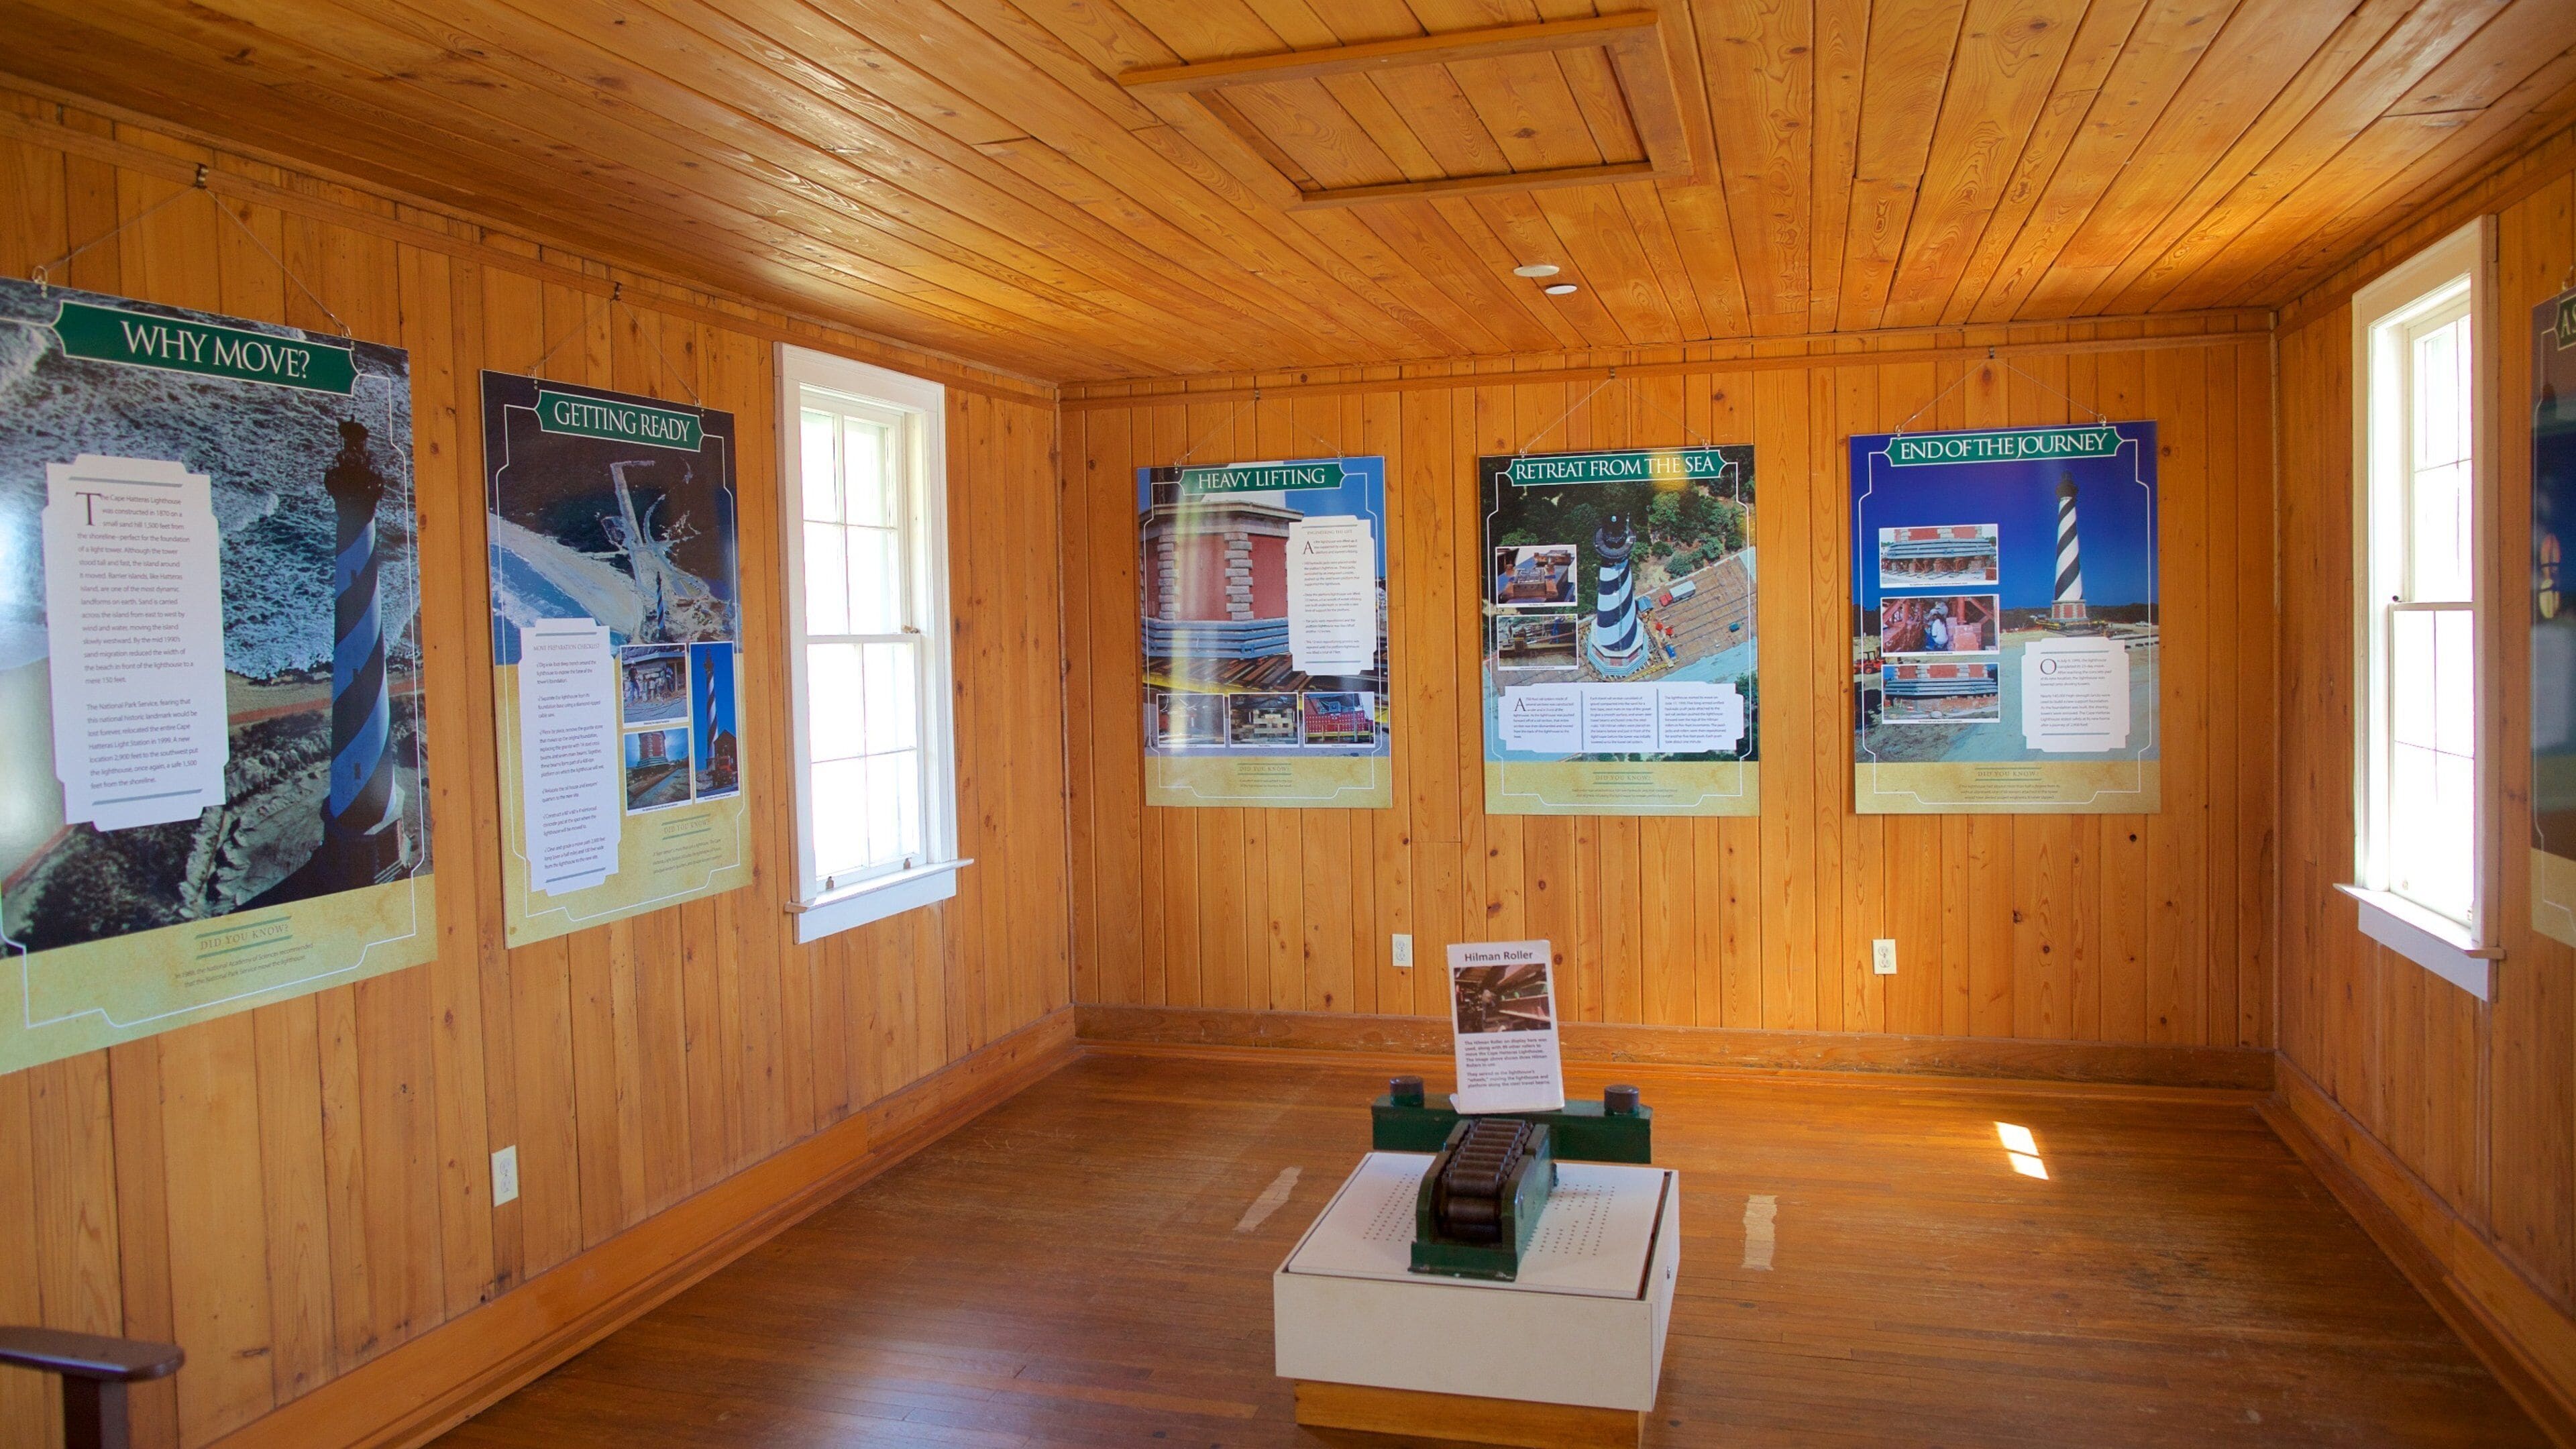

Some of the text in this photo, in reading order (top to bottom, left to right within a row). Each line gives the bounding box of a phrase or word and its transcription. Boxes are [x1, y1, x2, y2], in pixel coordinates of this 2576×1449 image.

[120, 320, 311, 379] WHY MOVE?
[553, 400, 690, 442] GETTING READY
[1900, 433, 2108, 460] END OF THE JOURNEY
[1198, 468, 1326, 490] HEAVY LIFTING
[1516, 455, 1715, 480] RETREAT FROM THE SEA
[200, 924, 289, 951] DID YOU KNOW?
[1464, 951, 1534, 962] Hilman Roller
